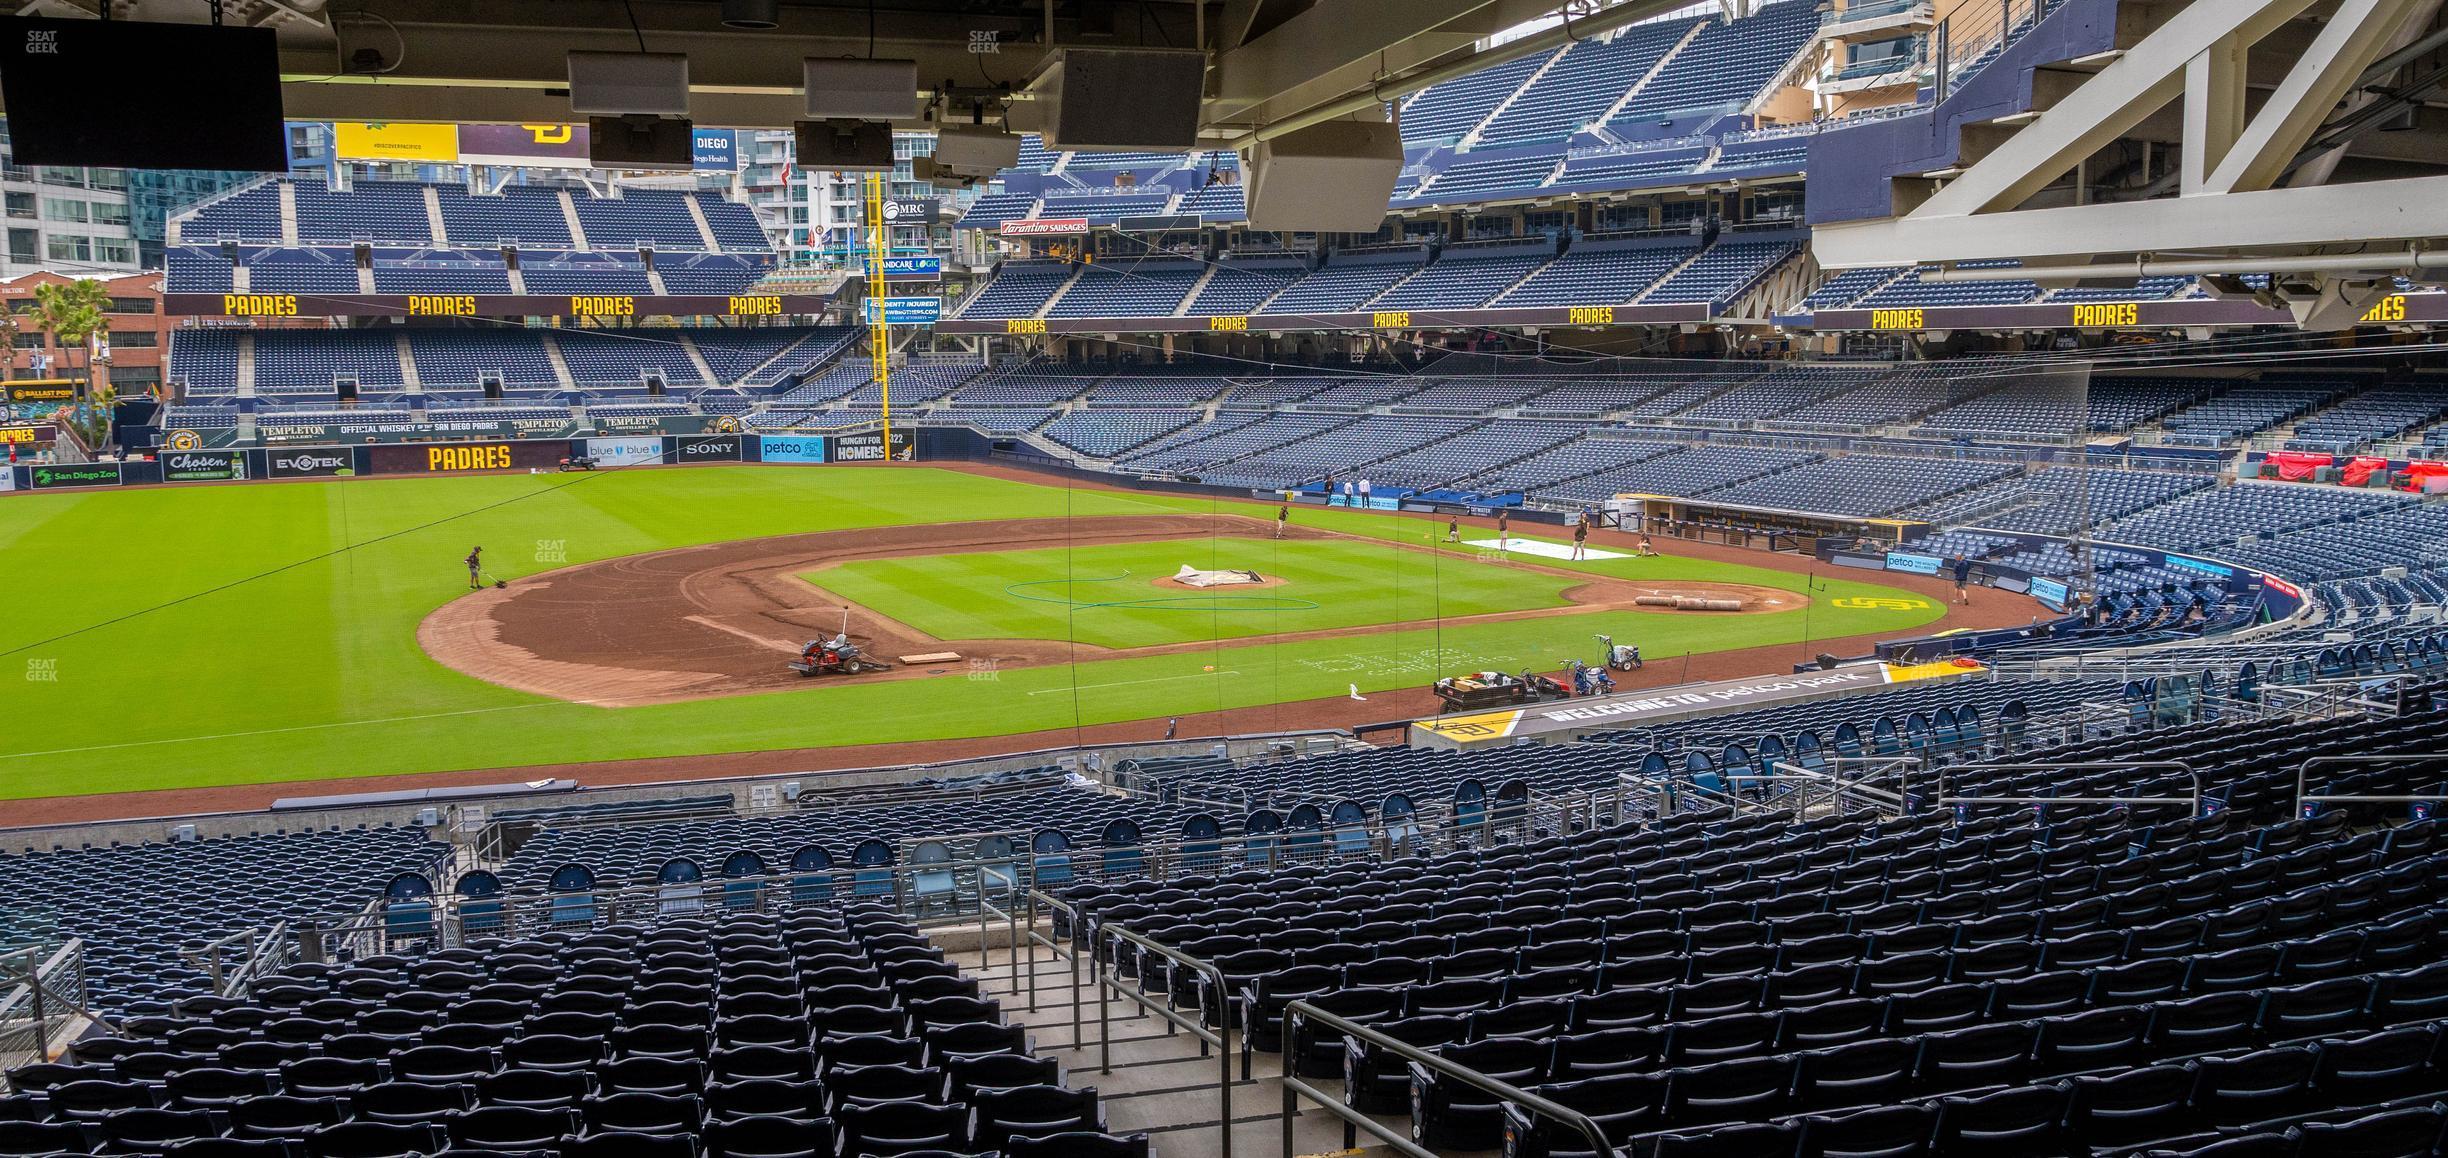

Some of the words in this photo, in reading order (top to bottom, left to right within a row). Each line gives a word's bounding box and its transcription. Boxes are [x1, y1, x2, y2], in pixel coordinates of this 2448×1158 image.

[697, 138, 727, 149] DIEGO
[899, 203, 925, 214] MRC
[1003, 222, 1049, 233] Tarantino
[1049, 223, 1086, 231] SAUSAGES
[915, 260, 939, 268] LOGIC
[224, 295, 297, 316] PADRES
[409, 296, 476, 315] PADRES
[572, 296, 634, 316] PADRES
[729, 296, 782, 315] PADRES
[2360, 296, 2406, 321] RES
[1374, 312, 1409, 327] PADRES
[1570, 307, 1613, 324] PADRES
[1873, 309, 1923, 329] PADRES
[2073, 303, 2137, 326] PADRES
[1008, 319, 1046, 333] PADRES
[1211, 316, 1248, 331] PADRES
[341, 425, 378, 434] OFFICIAL
[379, 424, 416, 433] WHISKEY
[434, 423, 449, 431] SAN
[450, 422, 471, 431] DIEGO
[472, 422, 499, 430] PADRES
[512, 418, 569, 429] TEMPLETON
[604, 417, 660, 427] TEMPLETON
[260, 426, 325, 437] TEMPLETON
[889, 433, 903, 444] 322
[840, 437, 867, 446] HUNGRY
[867, 436, 881, 445] FOR
[590, 446, 614, 456] blue
[627, 445, 649, 455] blue
[686, 443, 734, 455] SONY
[764, 442, 801, 456] petco
[837, 445, 885, 460] HOMERS
[169, 453, 228, 469] Chosen
[276, 455, 345, 471] EVOTEK
[428, 445, 512, 471] PADRES
[55, 472, 72, 480] San
[73, 471, 99, 480] Diego
[100, 470, 118, 478] Zoo
[1888, 557, 1914, 568] petco
[2032, 582, 2049, 594] petco
[1543, 697, 1668, 722] WELCOME
[1671, 692, 1708, 706] TO
[1714, 680, 1803, 700] petco
[1799, 670, 1873, 690] park
